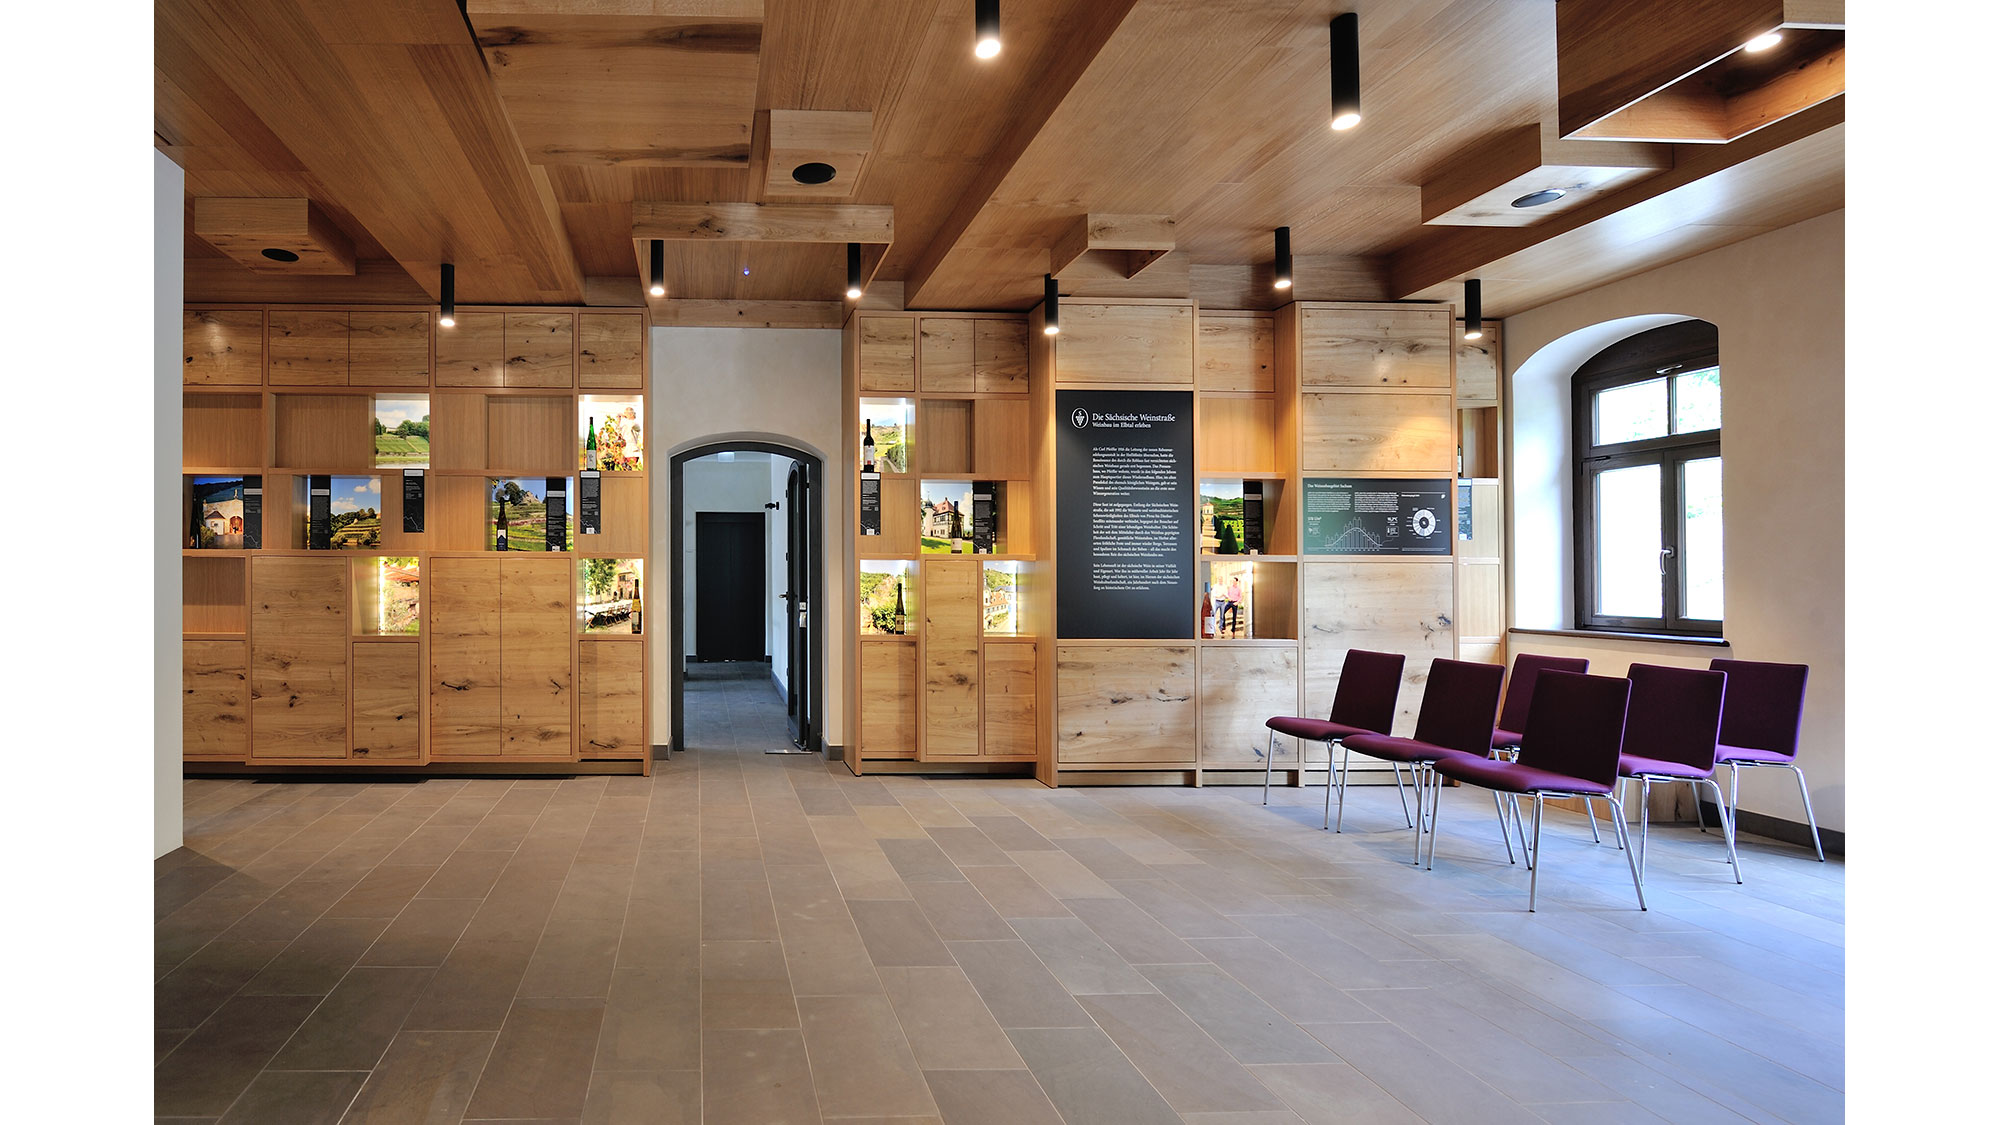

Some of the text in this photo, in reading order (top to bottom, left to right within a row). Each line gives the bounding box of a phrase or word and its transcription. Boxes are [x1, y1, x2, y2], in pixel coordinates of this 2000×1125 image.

[1092, 413, 1176, 422] Die Sächsische Weinstraße
